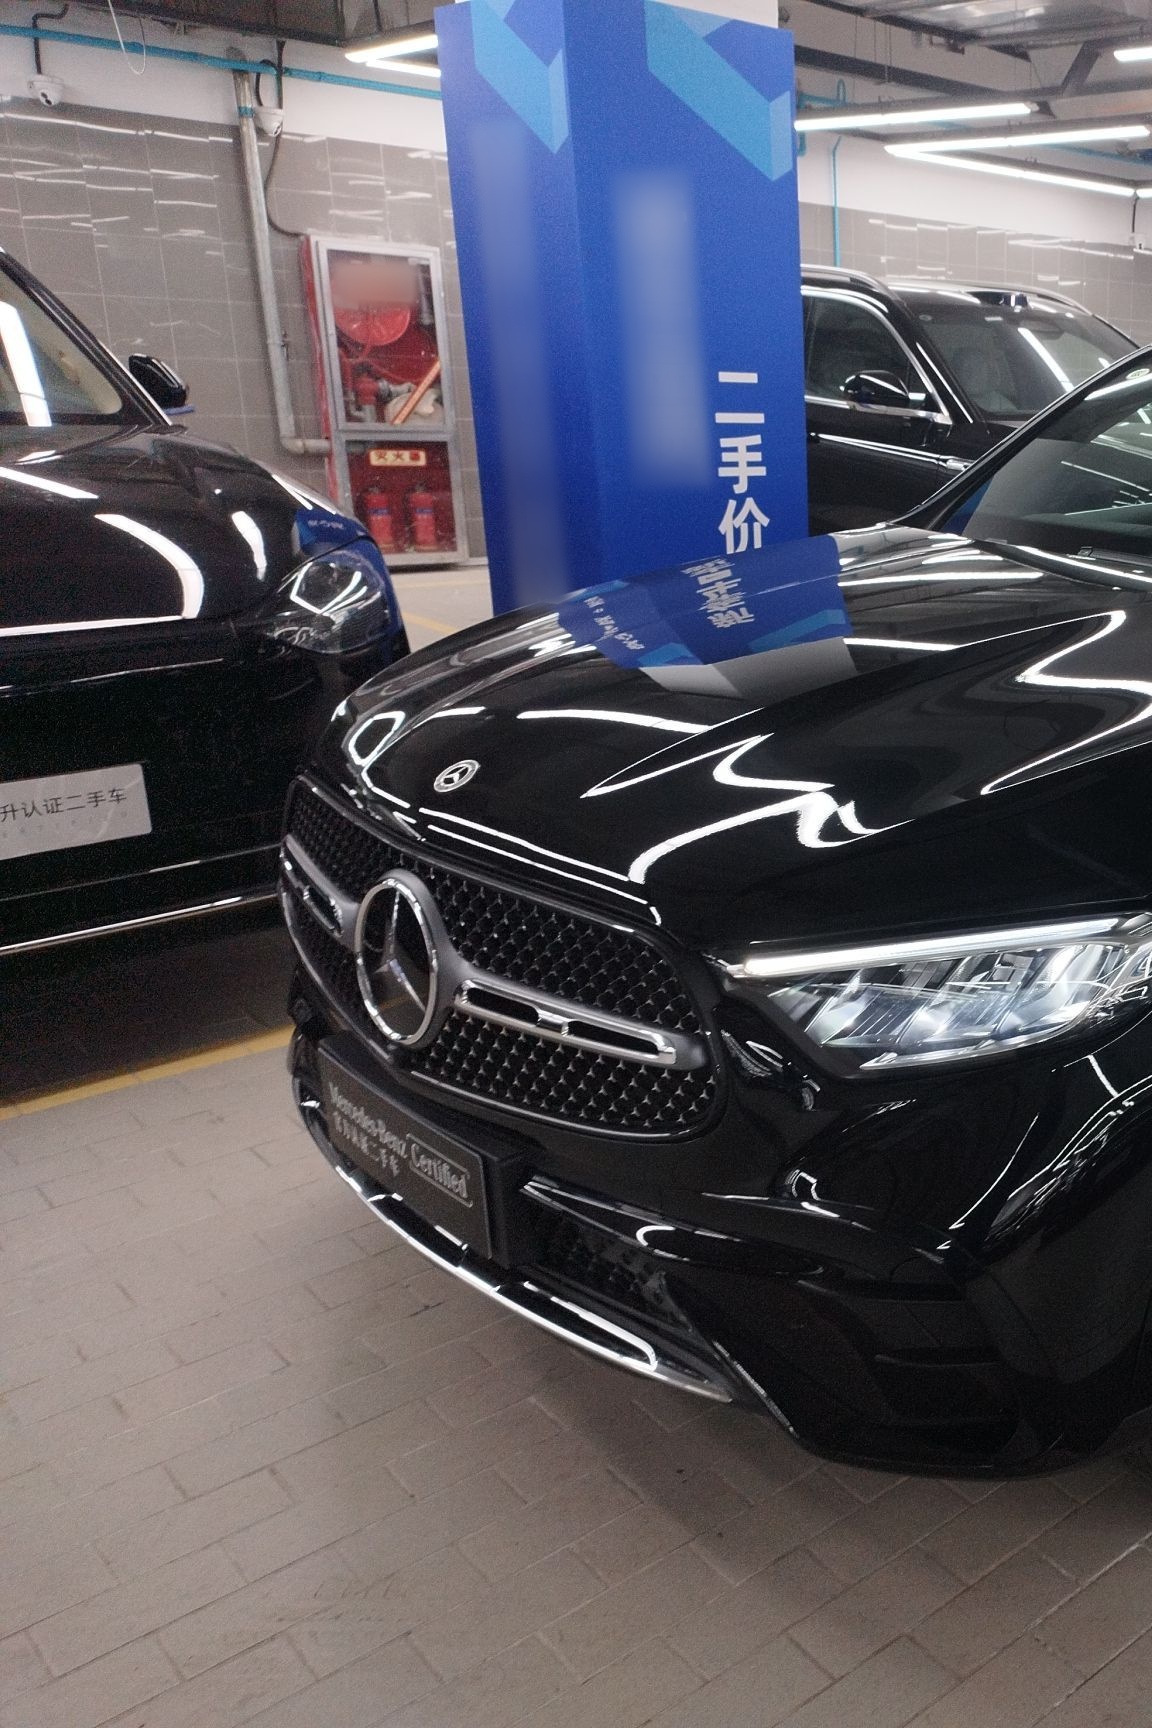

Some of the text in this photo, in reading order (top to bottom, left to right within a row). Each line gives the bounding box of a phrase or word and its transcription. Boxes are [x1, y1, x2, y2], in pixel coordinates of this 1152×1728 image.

[714, 371, 770, 555] 二手价
[410, 1143, 469, 1200] Certified
